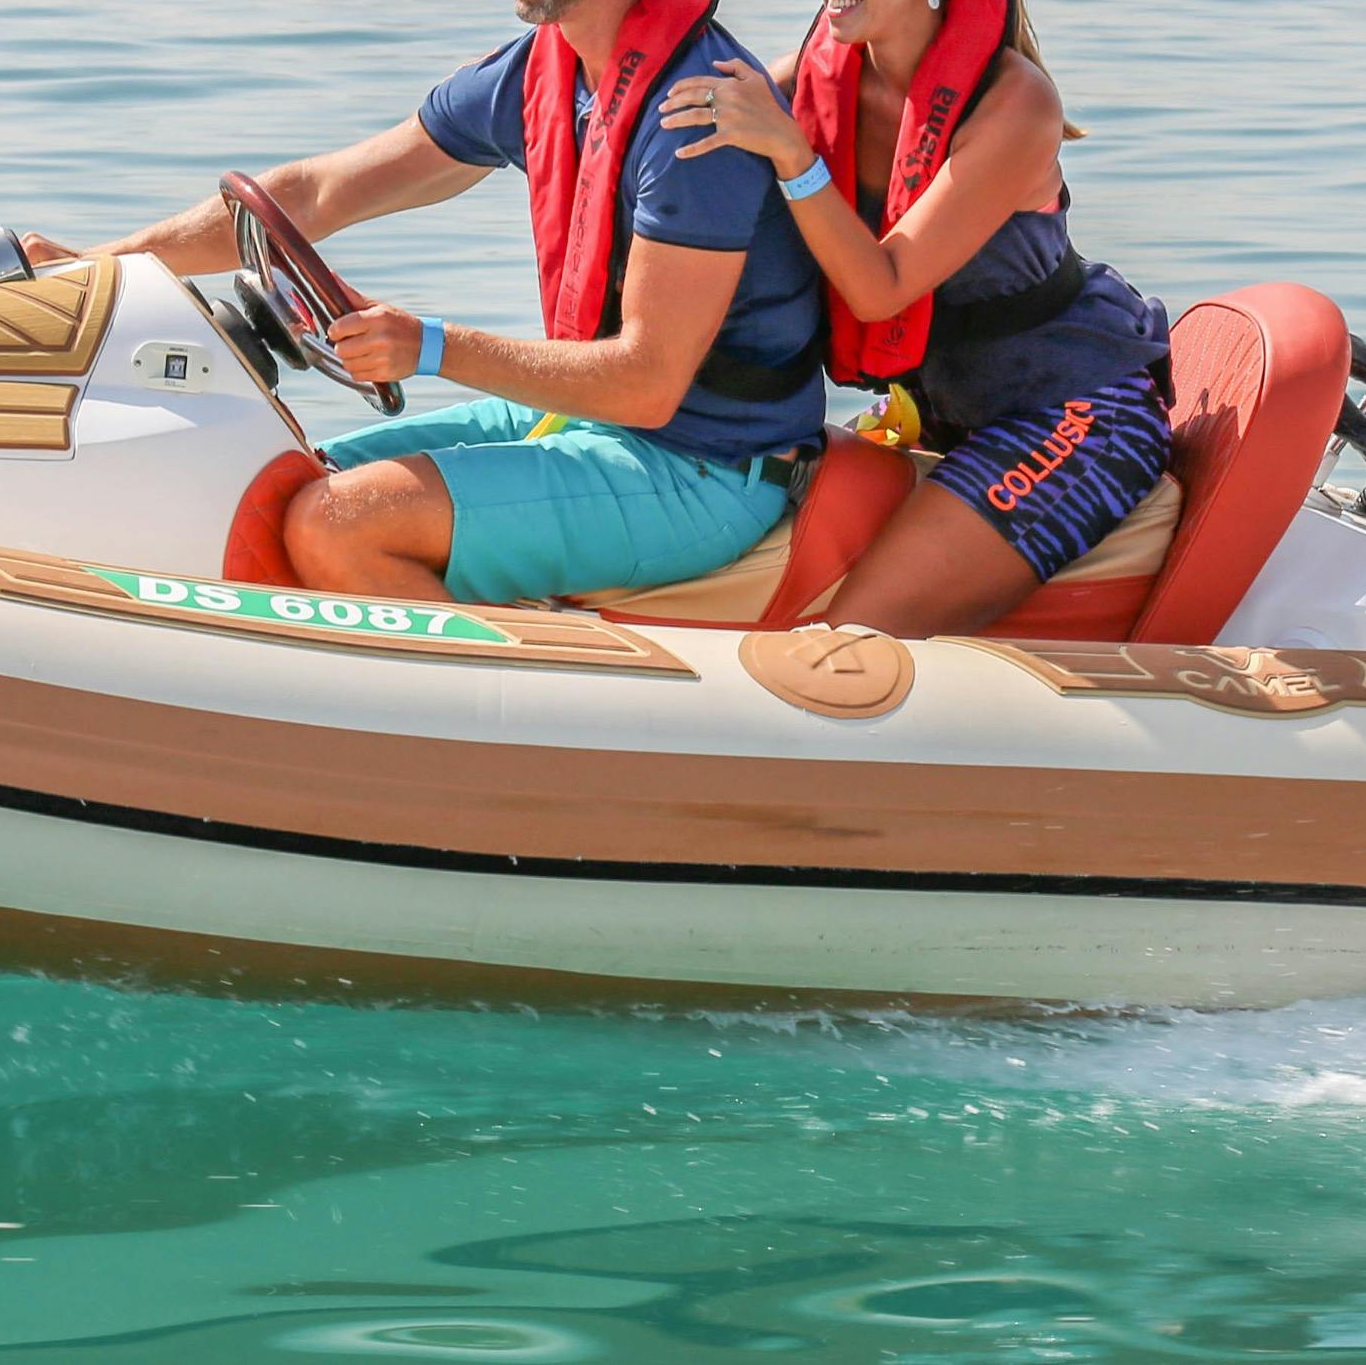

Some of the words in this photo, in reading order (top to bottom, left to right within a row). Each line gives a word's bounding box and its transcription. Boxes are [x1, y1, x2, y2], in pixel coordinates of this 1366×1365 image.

[137, 575, 242, 612] DS
[269, 594, 455, 636] 6087
[1176, 669, 1341, 697] CAMEL
